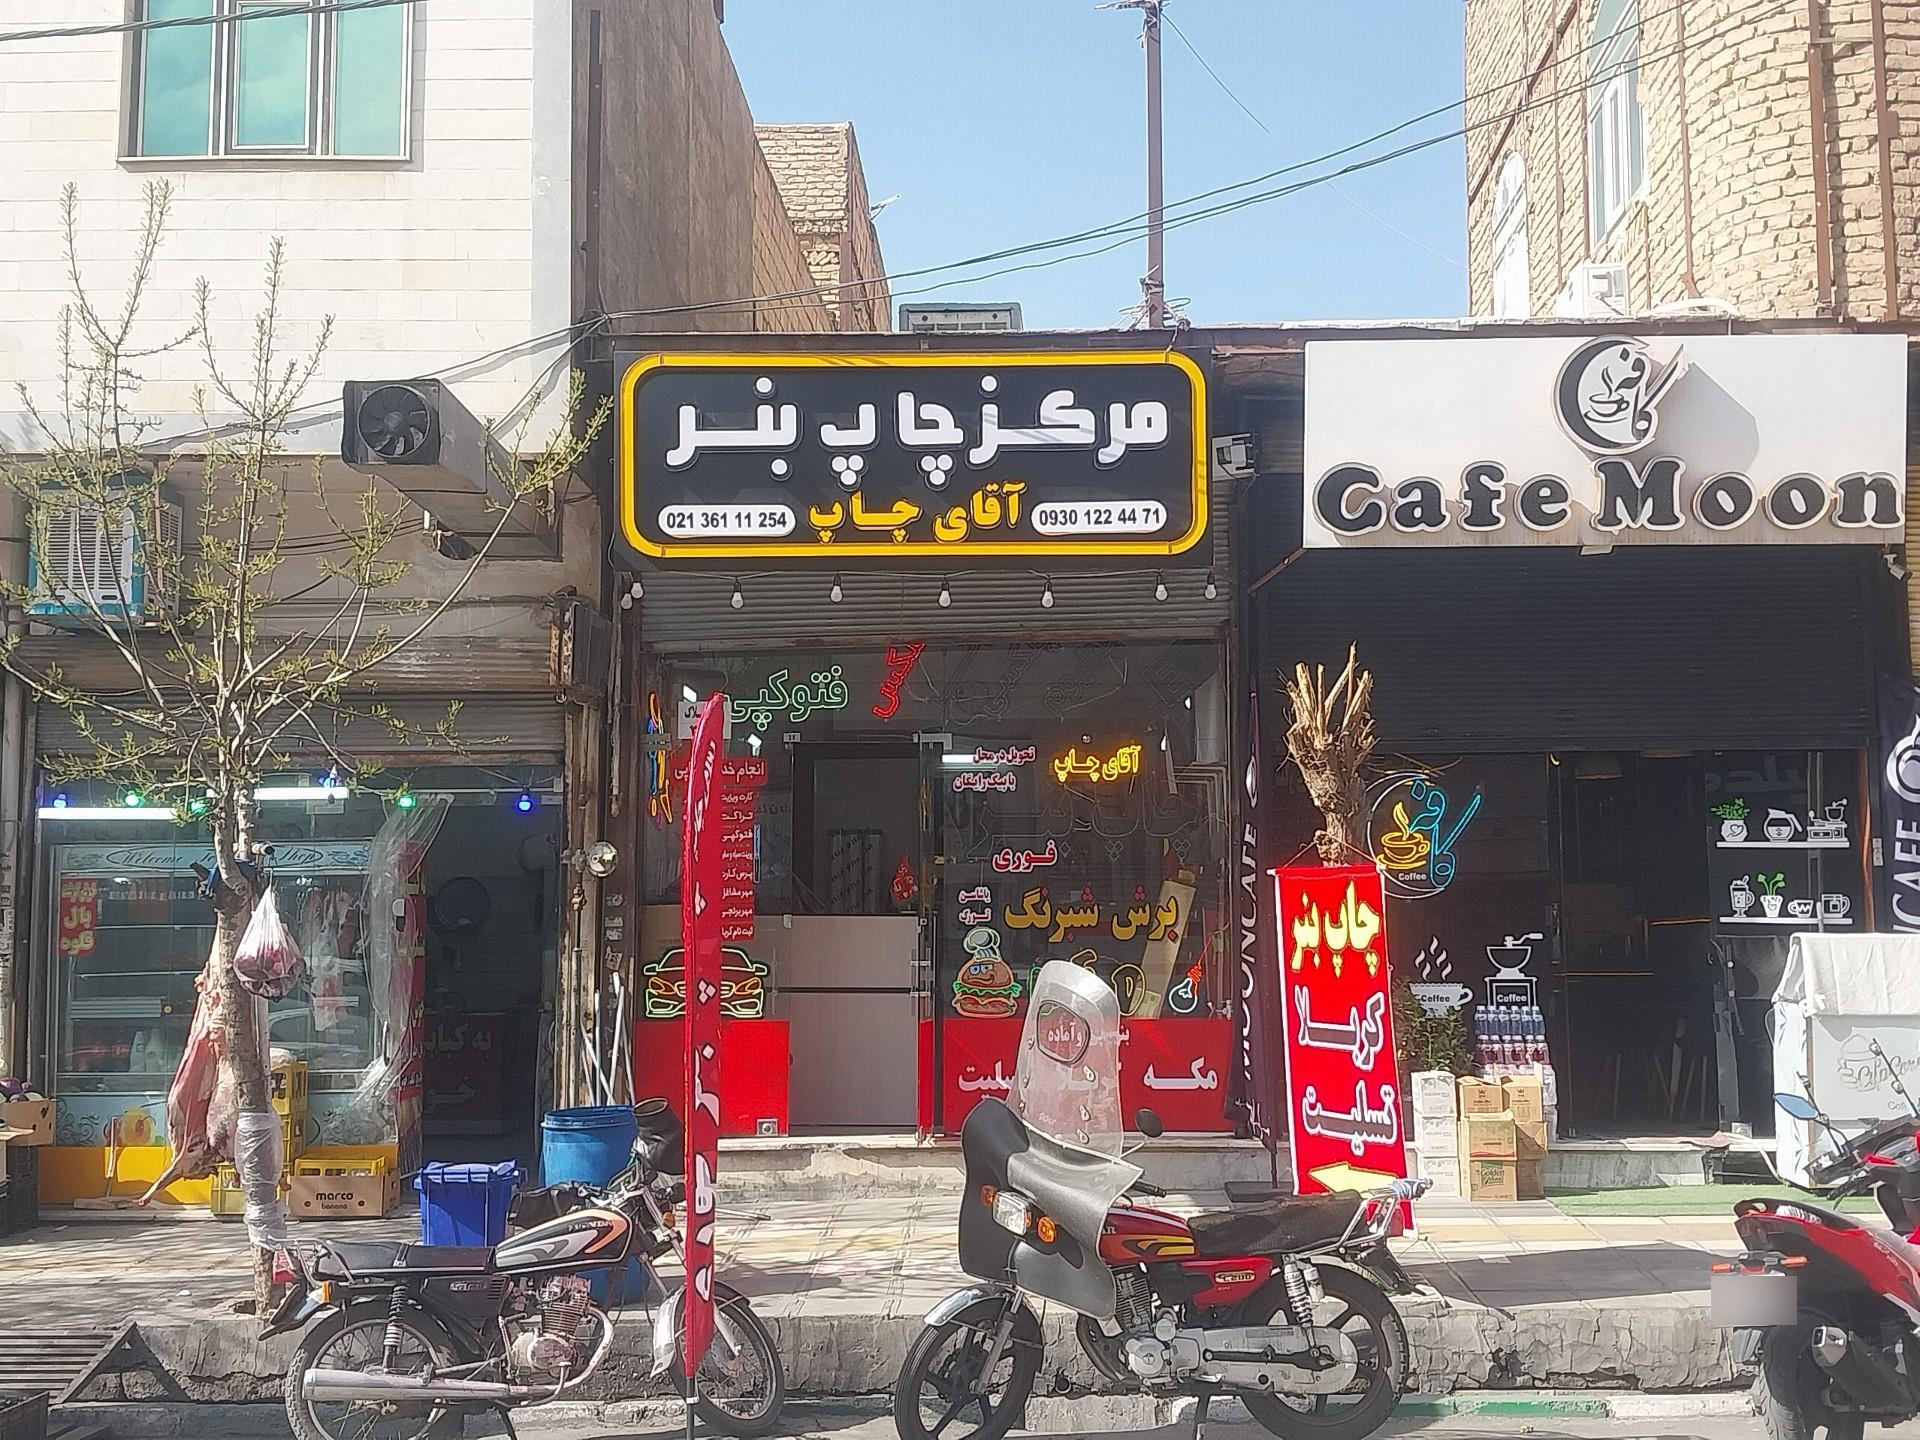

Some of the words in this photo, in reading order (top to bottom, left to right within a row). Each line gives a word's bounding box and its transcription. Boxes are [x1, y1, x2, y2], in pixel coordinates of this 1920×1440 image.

[665, 376, 798, 477] بنر
[820, 391, 965, 486] چاپ
[966, 376, 1169, 468] مرکز
[1314, 461, 1573, 532] Cafe
[1592, 455, 1905, 532] Moon
[666, 513, 697, 530] 021
[700, 512, 730, 529] 361
[734, 512, 752, 529] 11
[756, 511, 787, 529] 254
[808, 491, 922, 543] چاپ
[932, 481, 1028, 543] آقای
[1038, 509, 1078, 526] 0930
[1083, 508, 1113, 525] 122
[1117, 507, 1139, 524] 44
[1142, 506, 1162, 523] 71
[730, 665, 848, 731] فتوکپی
[737, 761, 765, 783] انجام
[973, 746, 995, 764] محل
[993, 749, 1007, 767] در
[1006, 745, 1036, 766] تحویل
[1053, 748, 1100, 782] چاپ
[1102, 745, 1143, 780] آقای
[721, 810, 754, 823] تراکت
[721, 828, 754, 842] فتوکپی
[119, 848, 183, 865] Welcome
[992, 839, 1058, 873] فوری
[1398, 872, 1427, 881] Coffee
[1004, 885, 1099, 943] شبرنگ
[1111, 885, 1179, 942] برش
[1323, 879, 1382, 979] چاپ
[1290, 889, 1321, 973] بنر
[1420, 992, 1451, 1003] Coffee
[1496, 991, 1527, 1002] Coffee
[1294, 984, 1385, 1071] کربلا
[1143, 1057, 1218, 1090] مکه
[1302, 1078, 1398, 1157] تسلیت
[315, 1192, 354, 1201] marco
